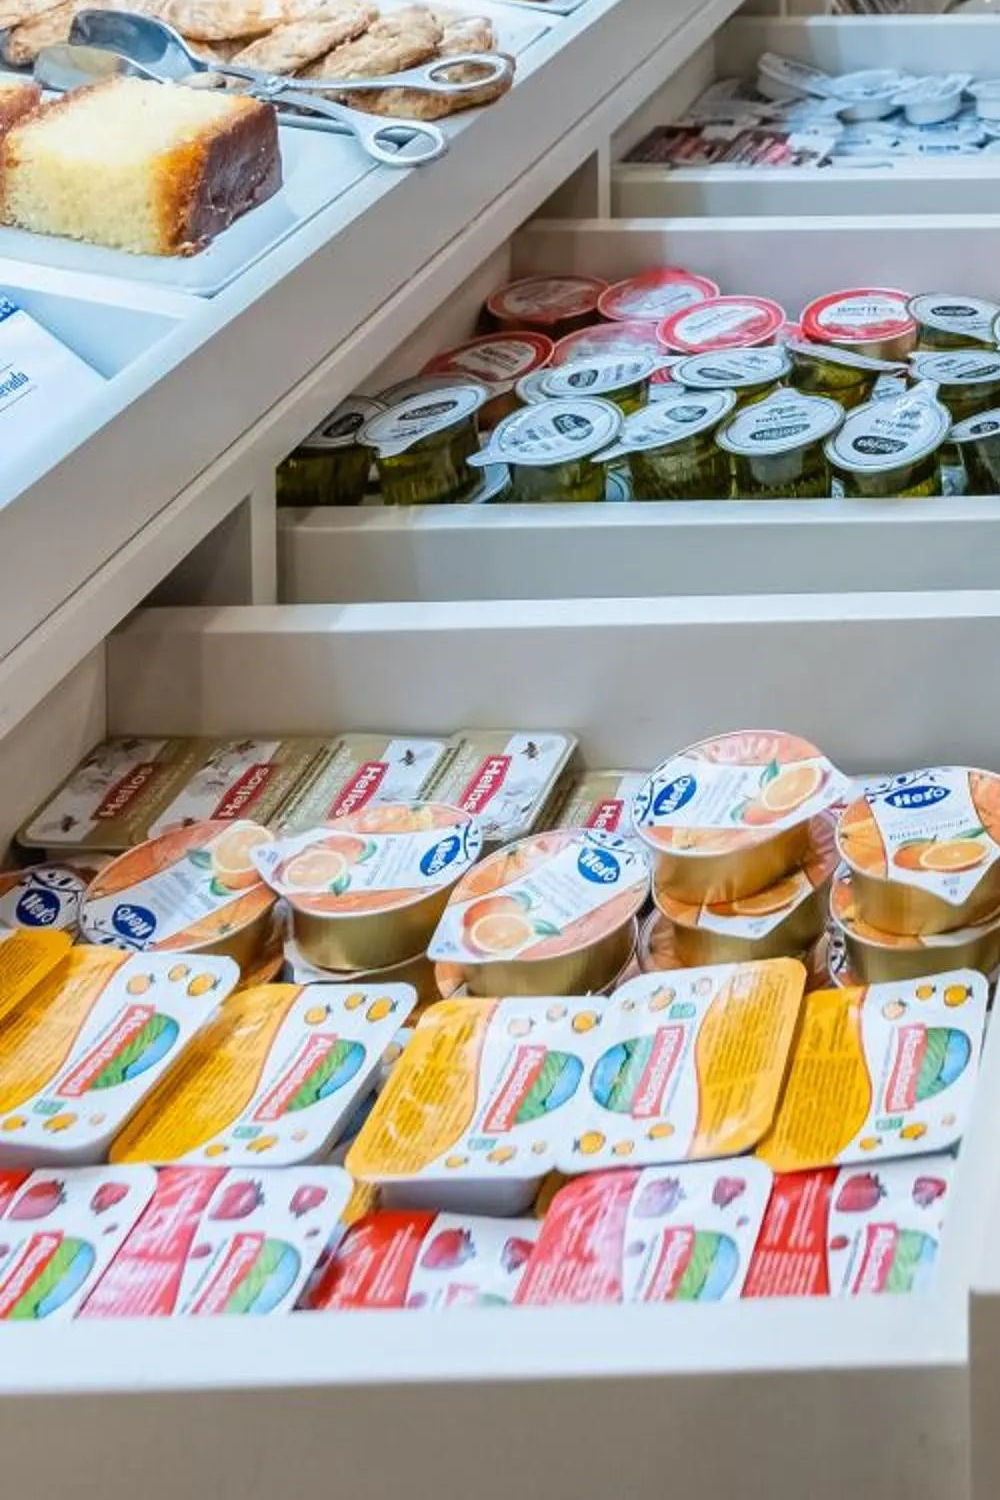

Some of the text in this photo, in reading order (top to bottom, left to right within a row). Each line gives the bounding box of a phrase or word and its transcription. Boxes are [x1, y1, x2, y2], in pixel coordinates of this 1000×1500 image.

[100, 765, 154, 818] Helios
[217, 766, 270, 818] Helios
[335, 765, 382, 818] Helios
[463, 759, 505, 811] Helios
[658, 777, 691, 812] Hero
[893, 787, 946, 807] Hero
[579, 849, 618, 882] Hero
[20, 893, 56, 924] Hero
[116, 906, 153, 937] Hero
